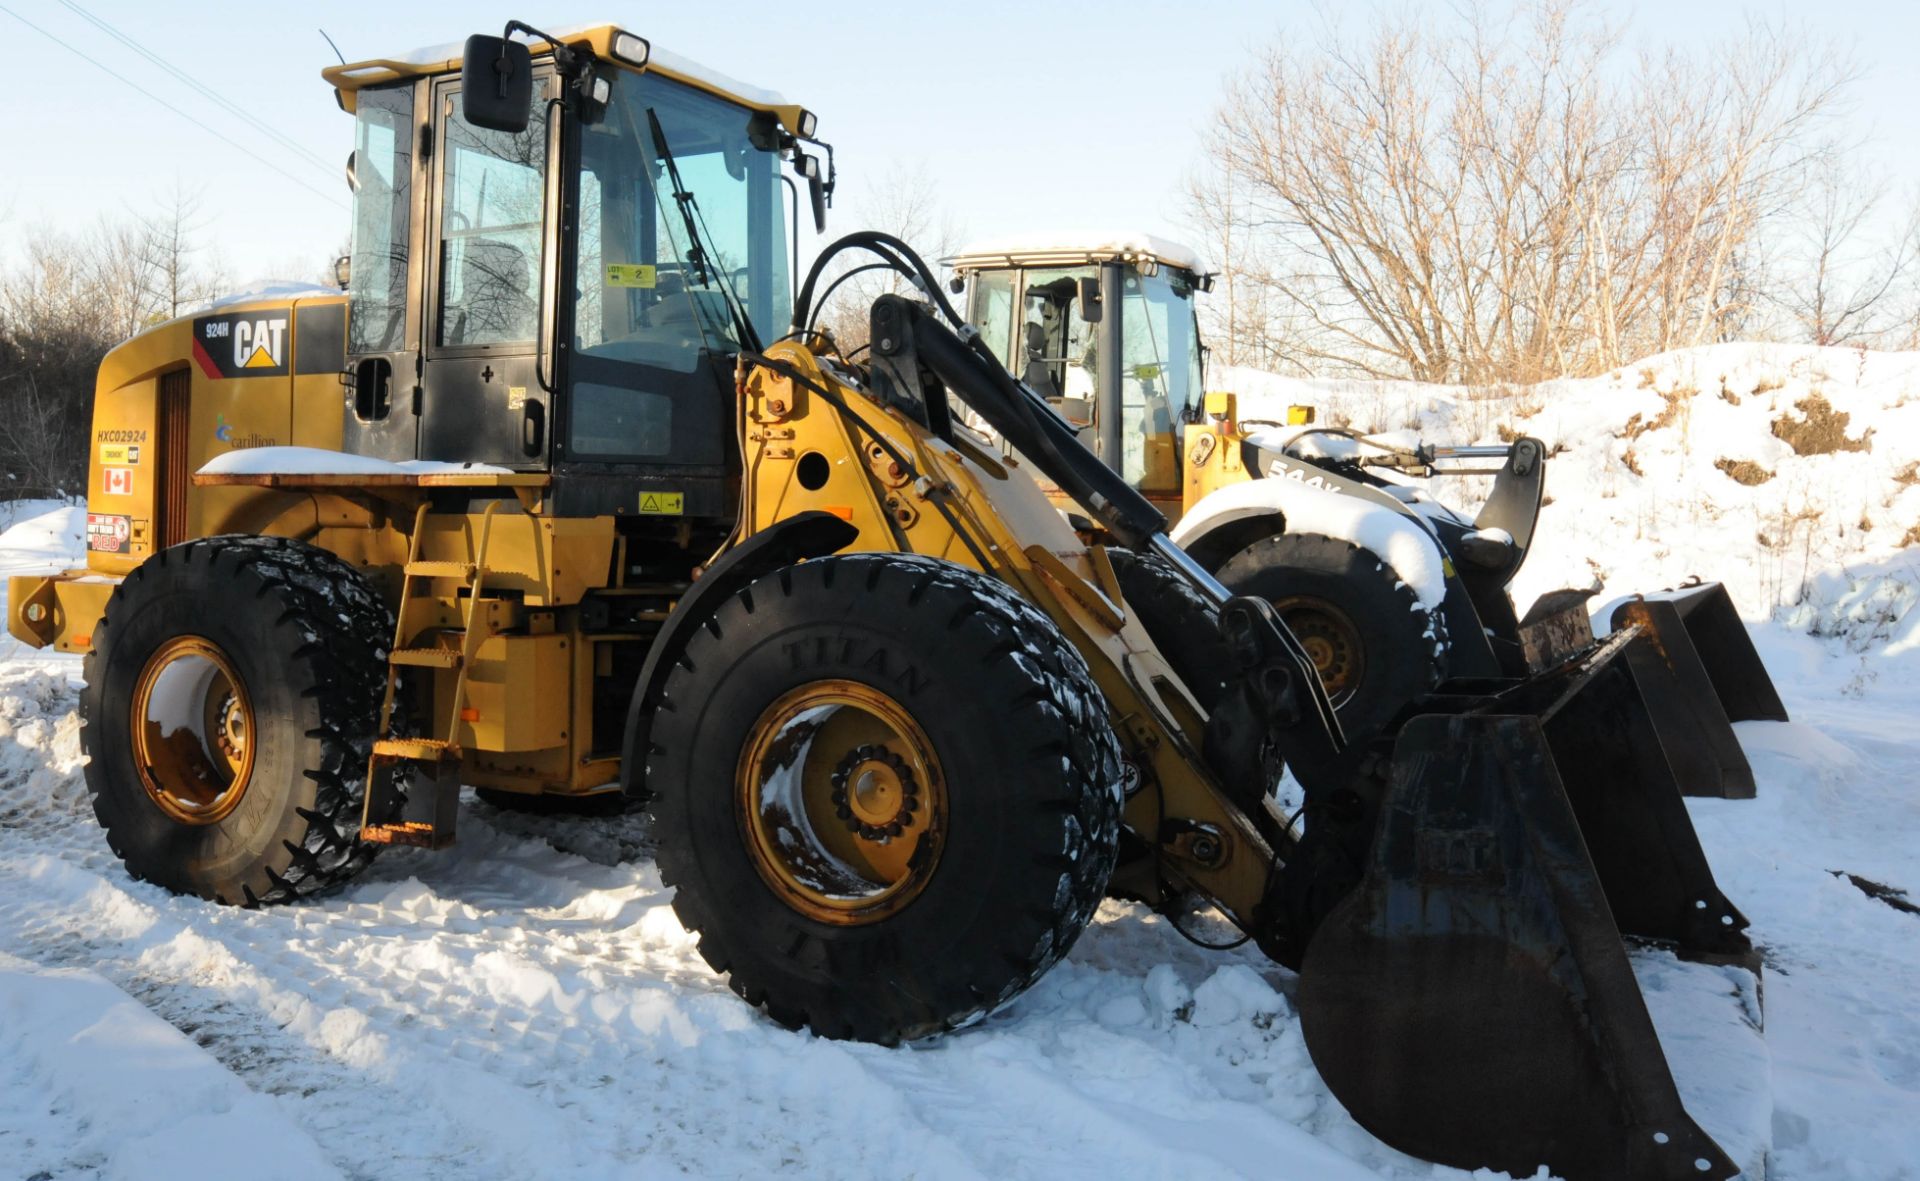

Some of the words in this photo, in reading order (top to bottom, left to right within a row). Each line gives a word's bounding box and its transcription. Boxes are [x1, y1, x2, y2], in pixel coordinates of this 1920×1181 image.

[206, 321, 229, 338] 924H
[234, 319, 287, 368] CAT
[97, 430, 147, 443] HXC02924
[92, 533, 121, 552] RED
[782, 636, 934, 697] TITAN
